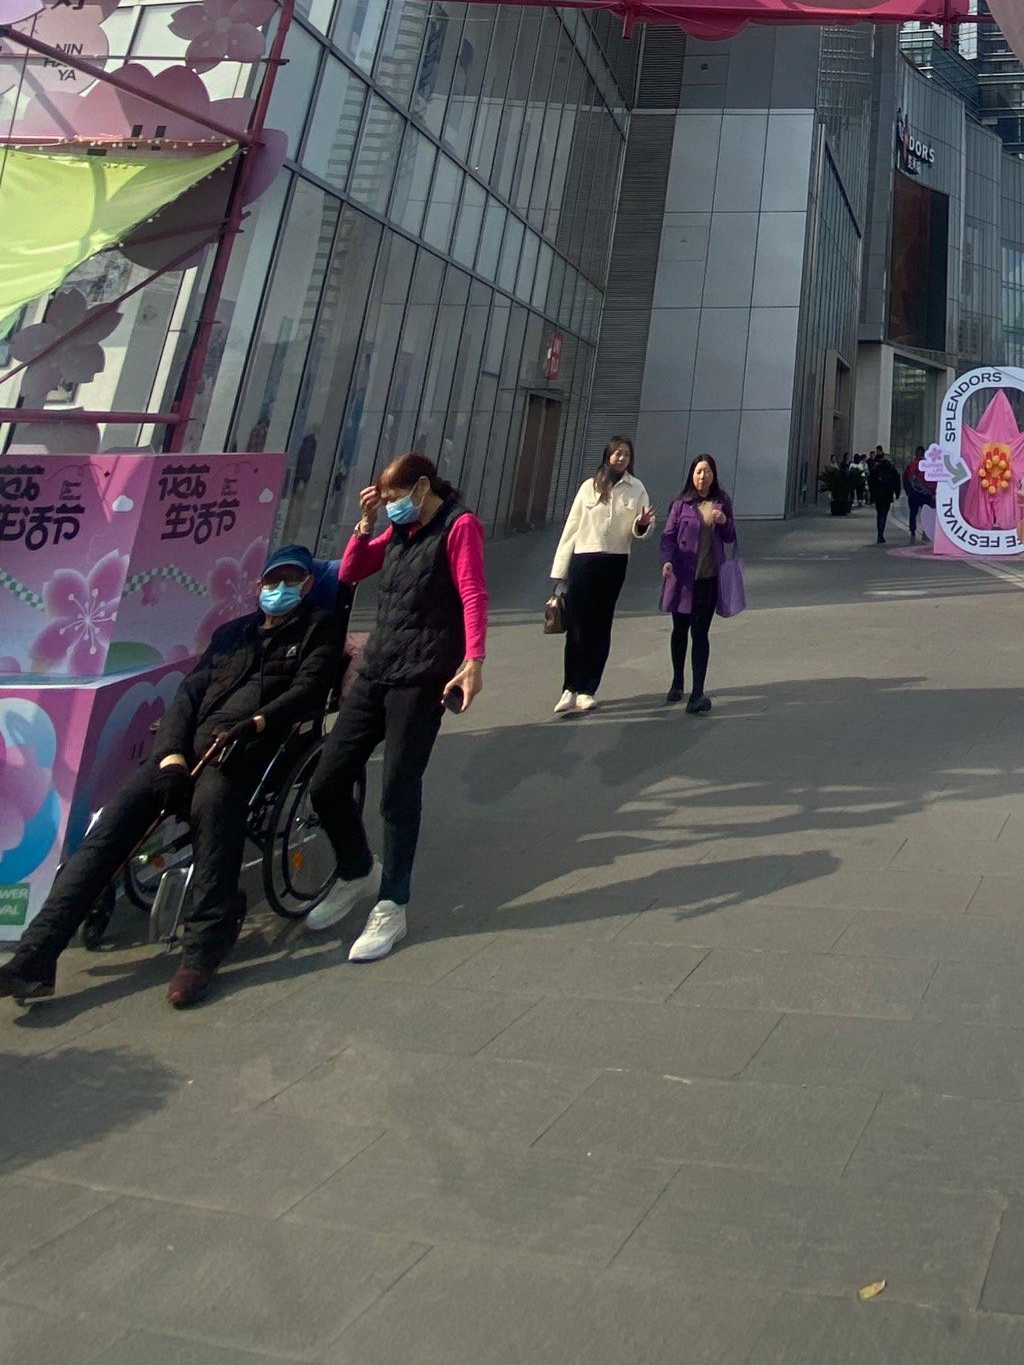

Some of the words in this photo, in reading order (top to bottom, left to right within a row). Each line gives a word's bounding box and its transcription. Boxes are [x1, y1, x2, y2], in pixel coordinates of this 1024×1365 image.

[58, 69, 76, 81] YA
[944, 371, 1002, 443] SPLENDORS
[942, 497, 1001, 548] FESTIVAL
